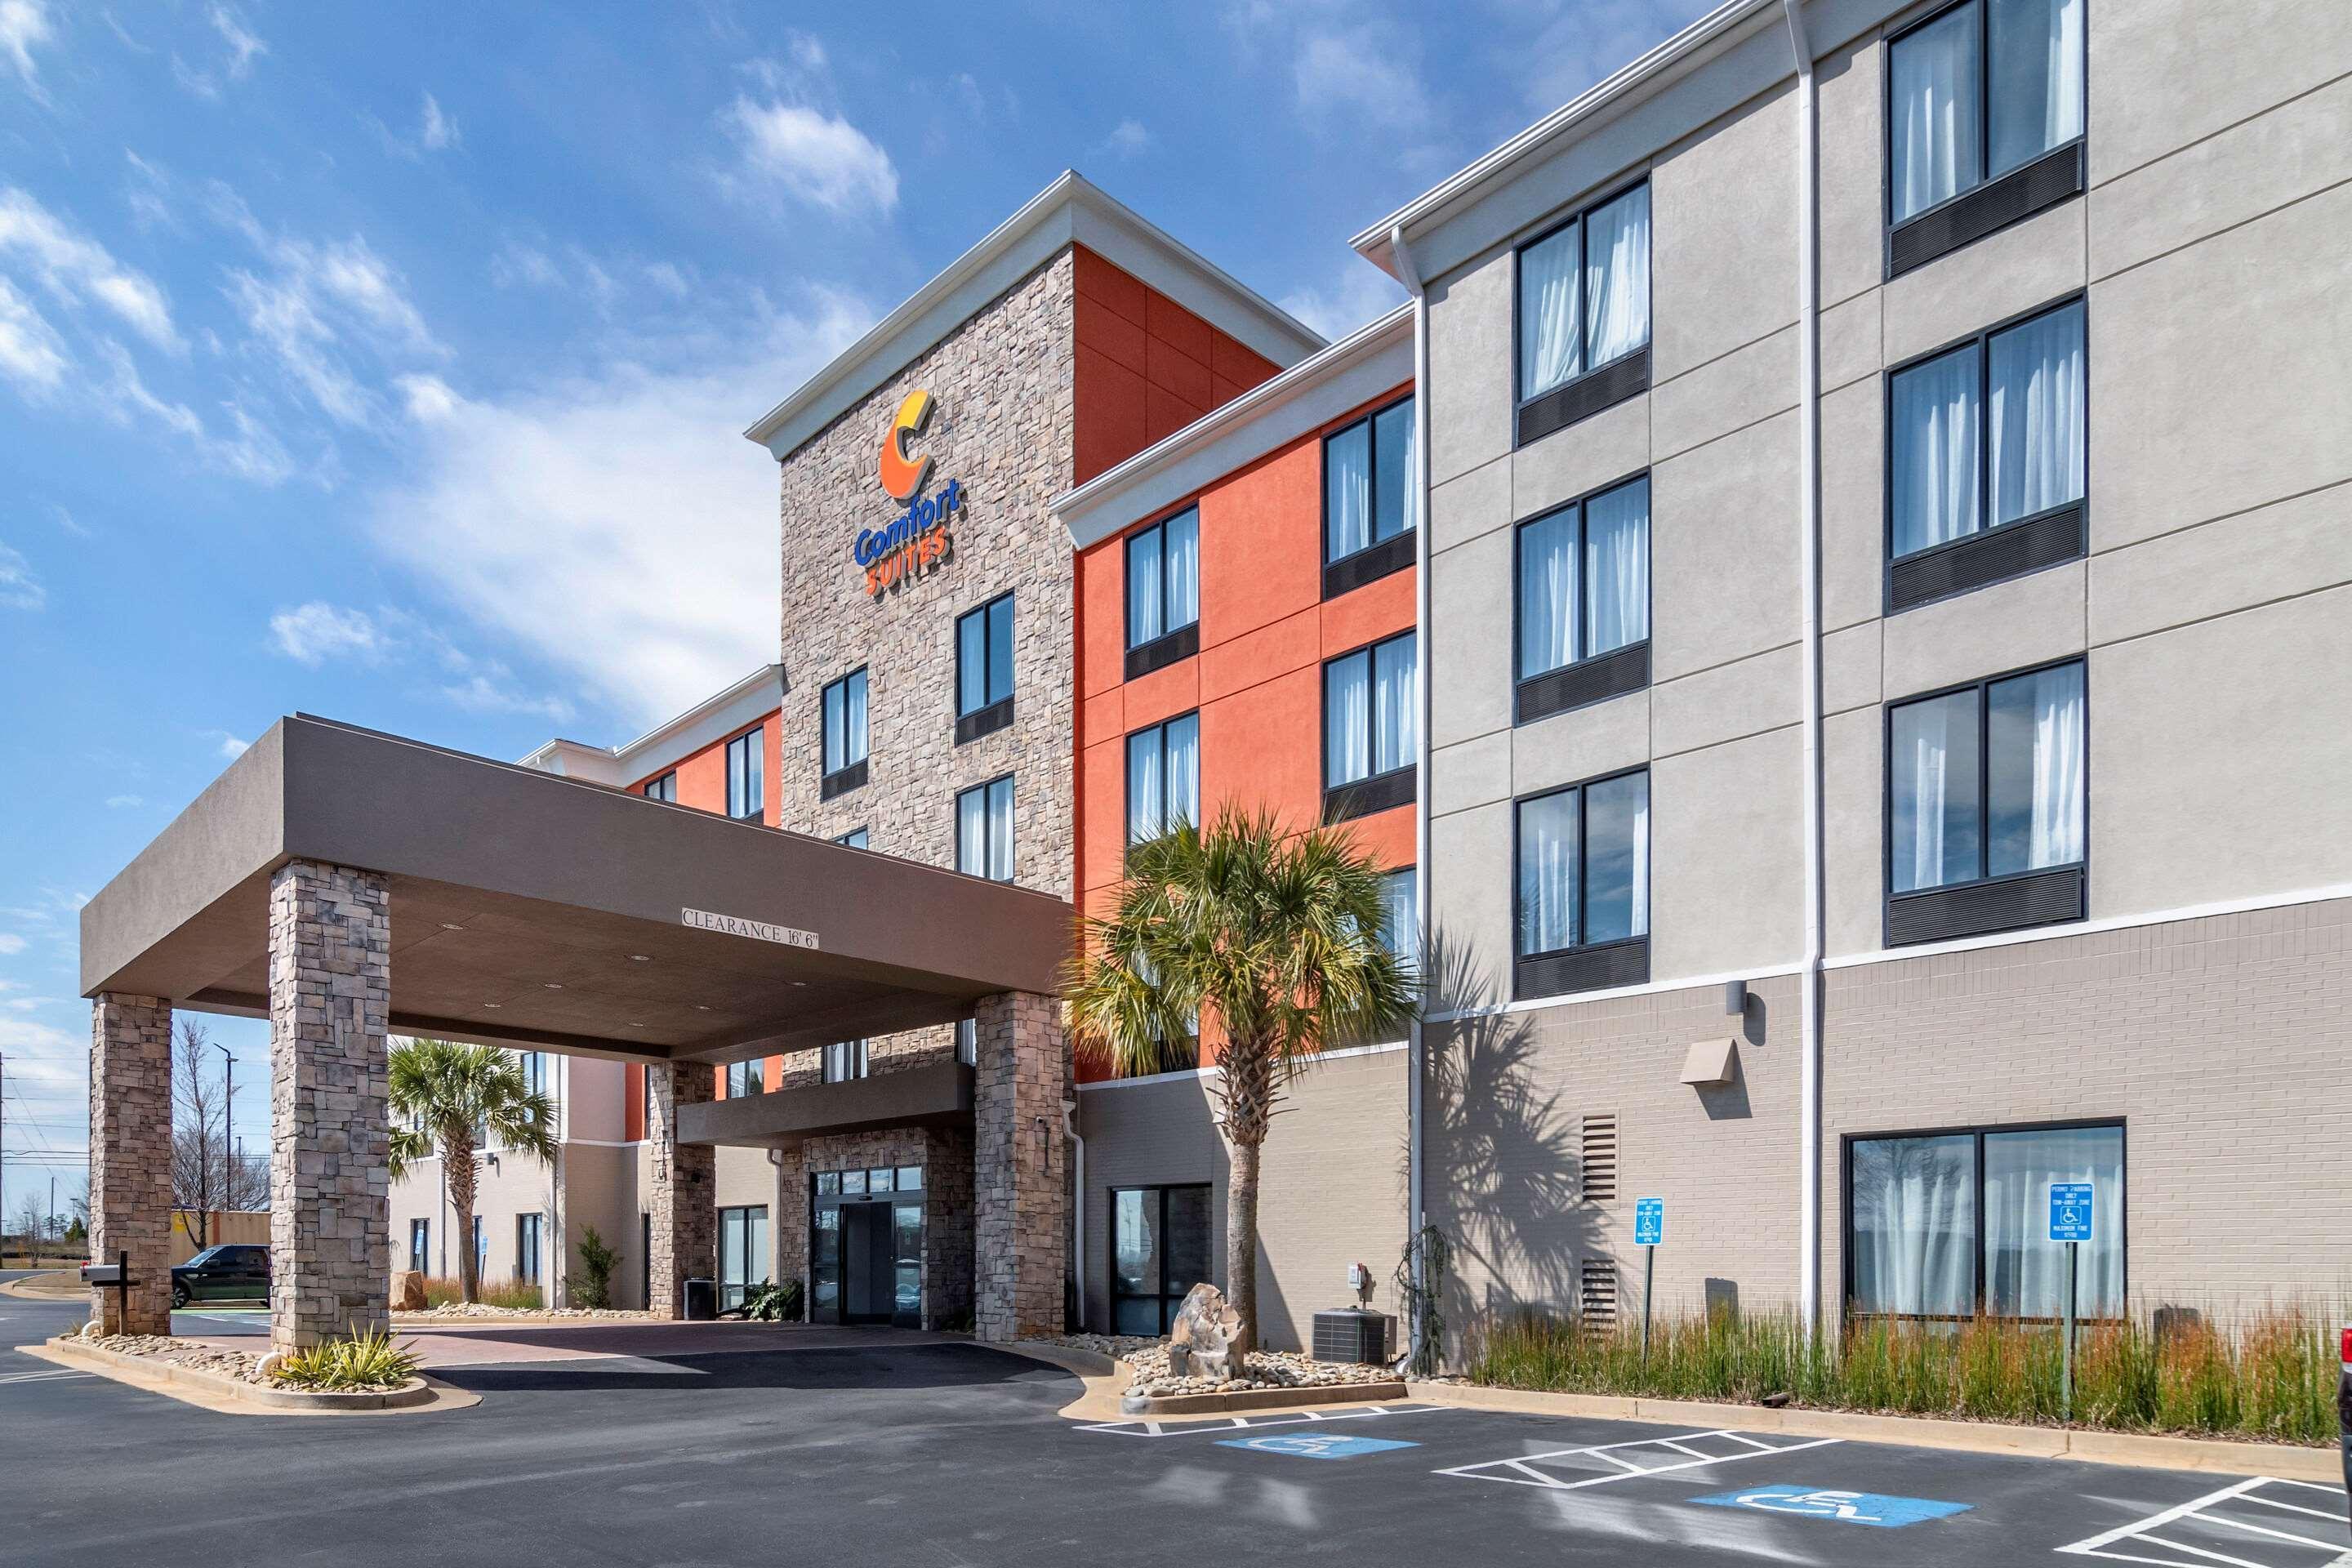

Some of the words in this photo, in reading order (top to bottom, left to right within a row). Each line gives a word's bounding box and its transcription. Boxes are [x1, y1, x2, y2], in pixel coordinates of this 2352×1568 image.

[854, 478, 960, 567] Comfort
[866, 525, 949, 596] SUITES
[683, 910, 781, 942] CLEARANCE
